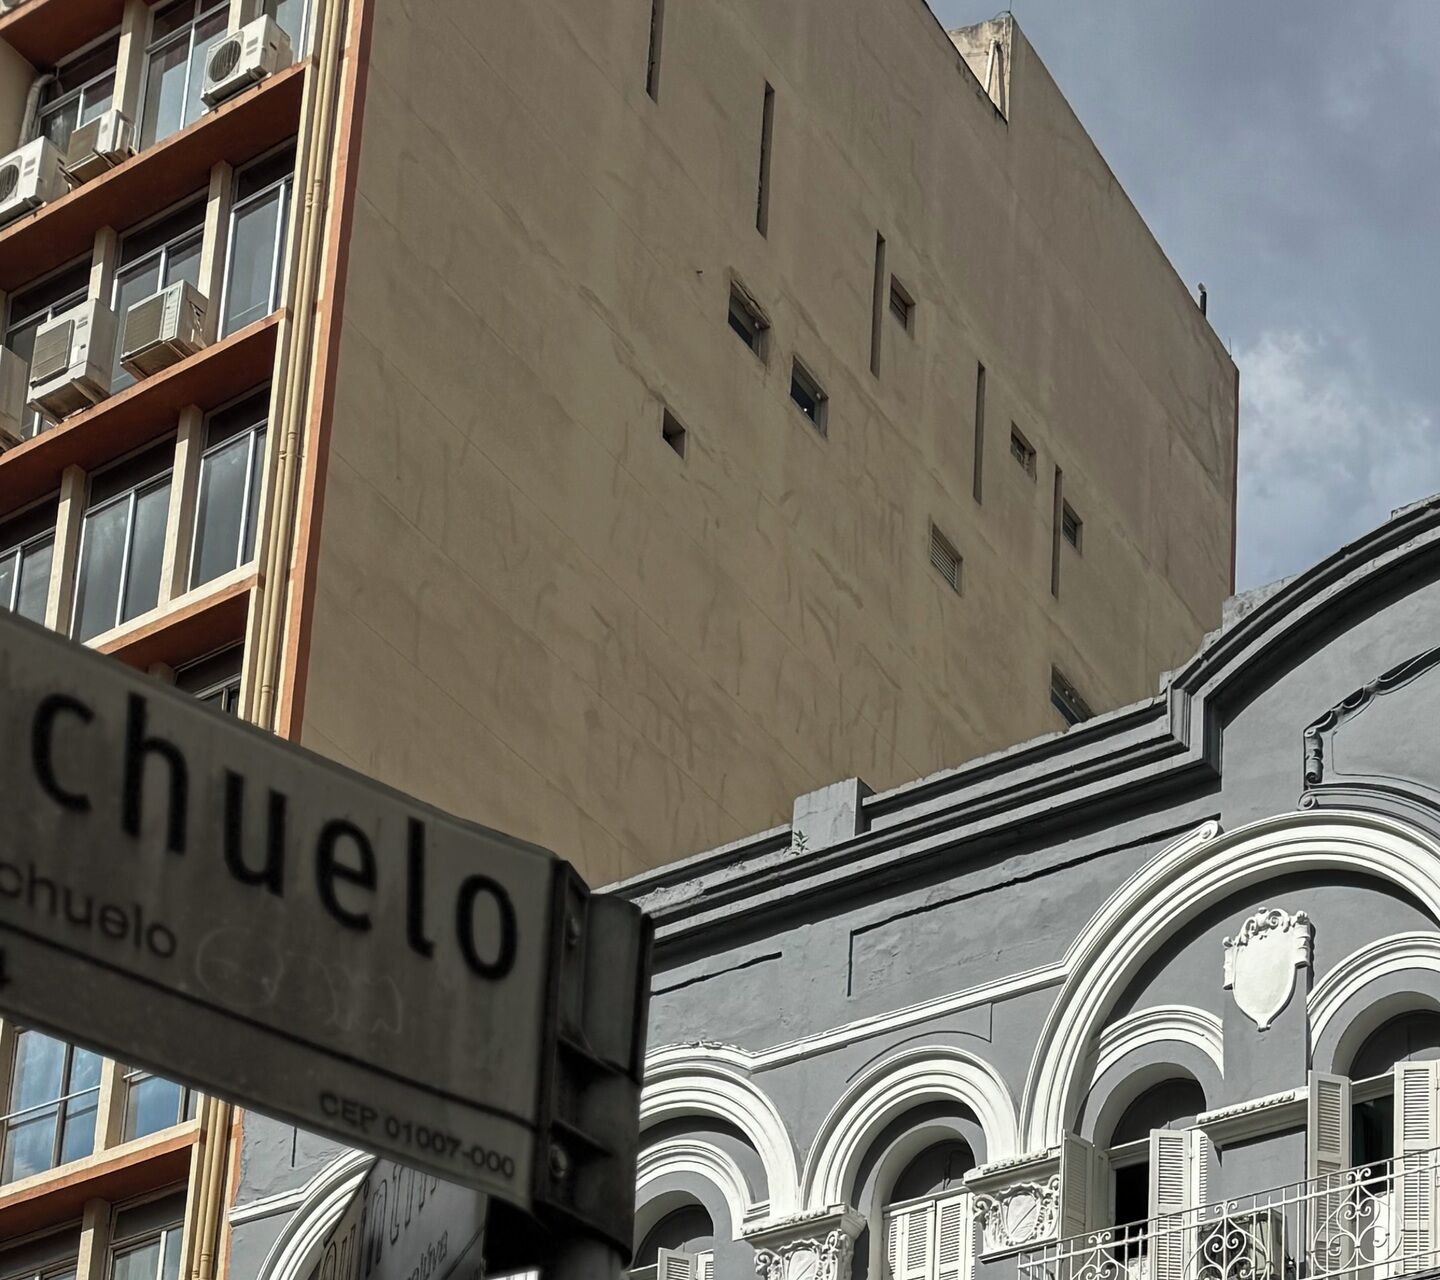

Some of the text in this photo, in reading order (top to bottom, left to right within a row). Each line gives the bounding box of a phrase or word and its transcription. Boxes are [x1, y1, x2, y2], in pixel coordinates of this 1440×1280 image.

[30, 692, 518, 982] chuelo
[318, 1092, 516, 1179] CEP 01007-000
